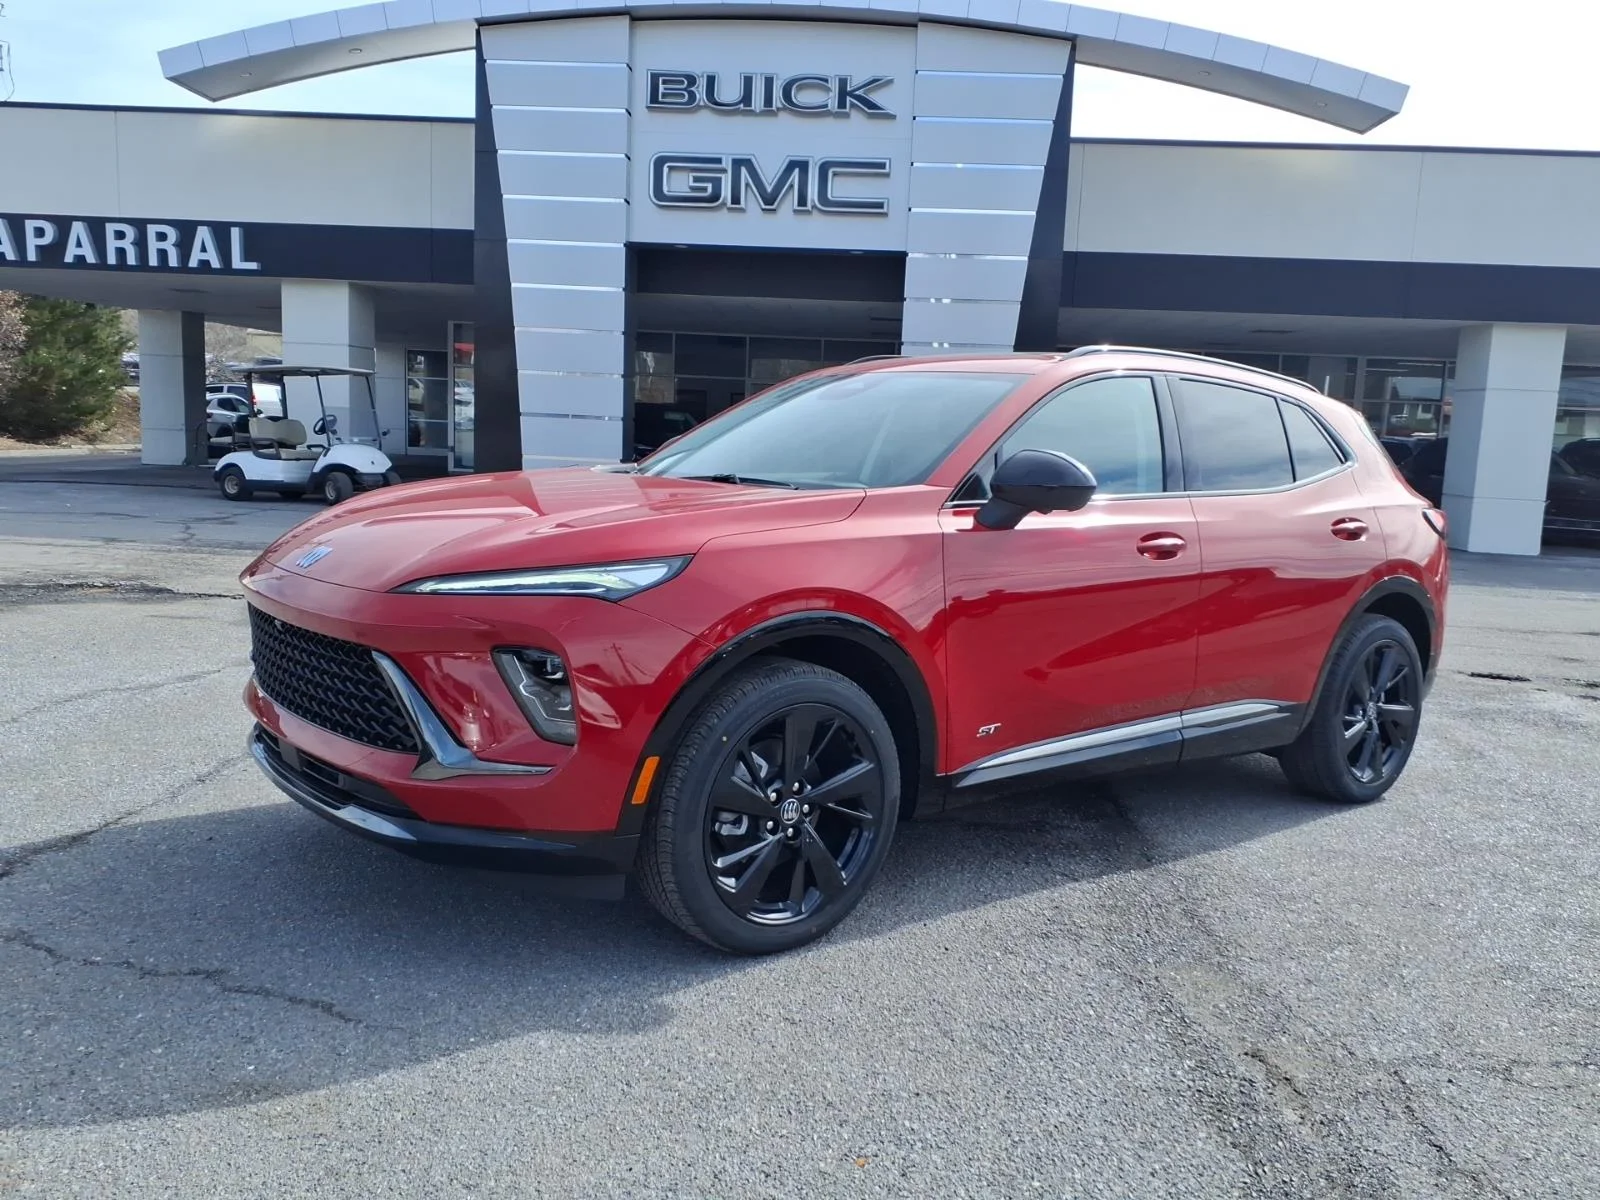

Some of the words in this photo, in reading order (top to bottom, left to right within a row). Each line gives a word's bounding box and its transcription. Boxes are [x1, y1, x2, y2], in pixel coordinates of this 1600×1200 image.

[646, 69, 896, 120] BUICK
[650, 151, 891, 217] GMC
[976, 722, 1001, 738] ST
